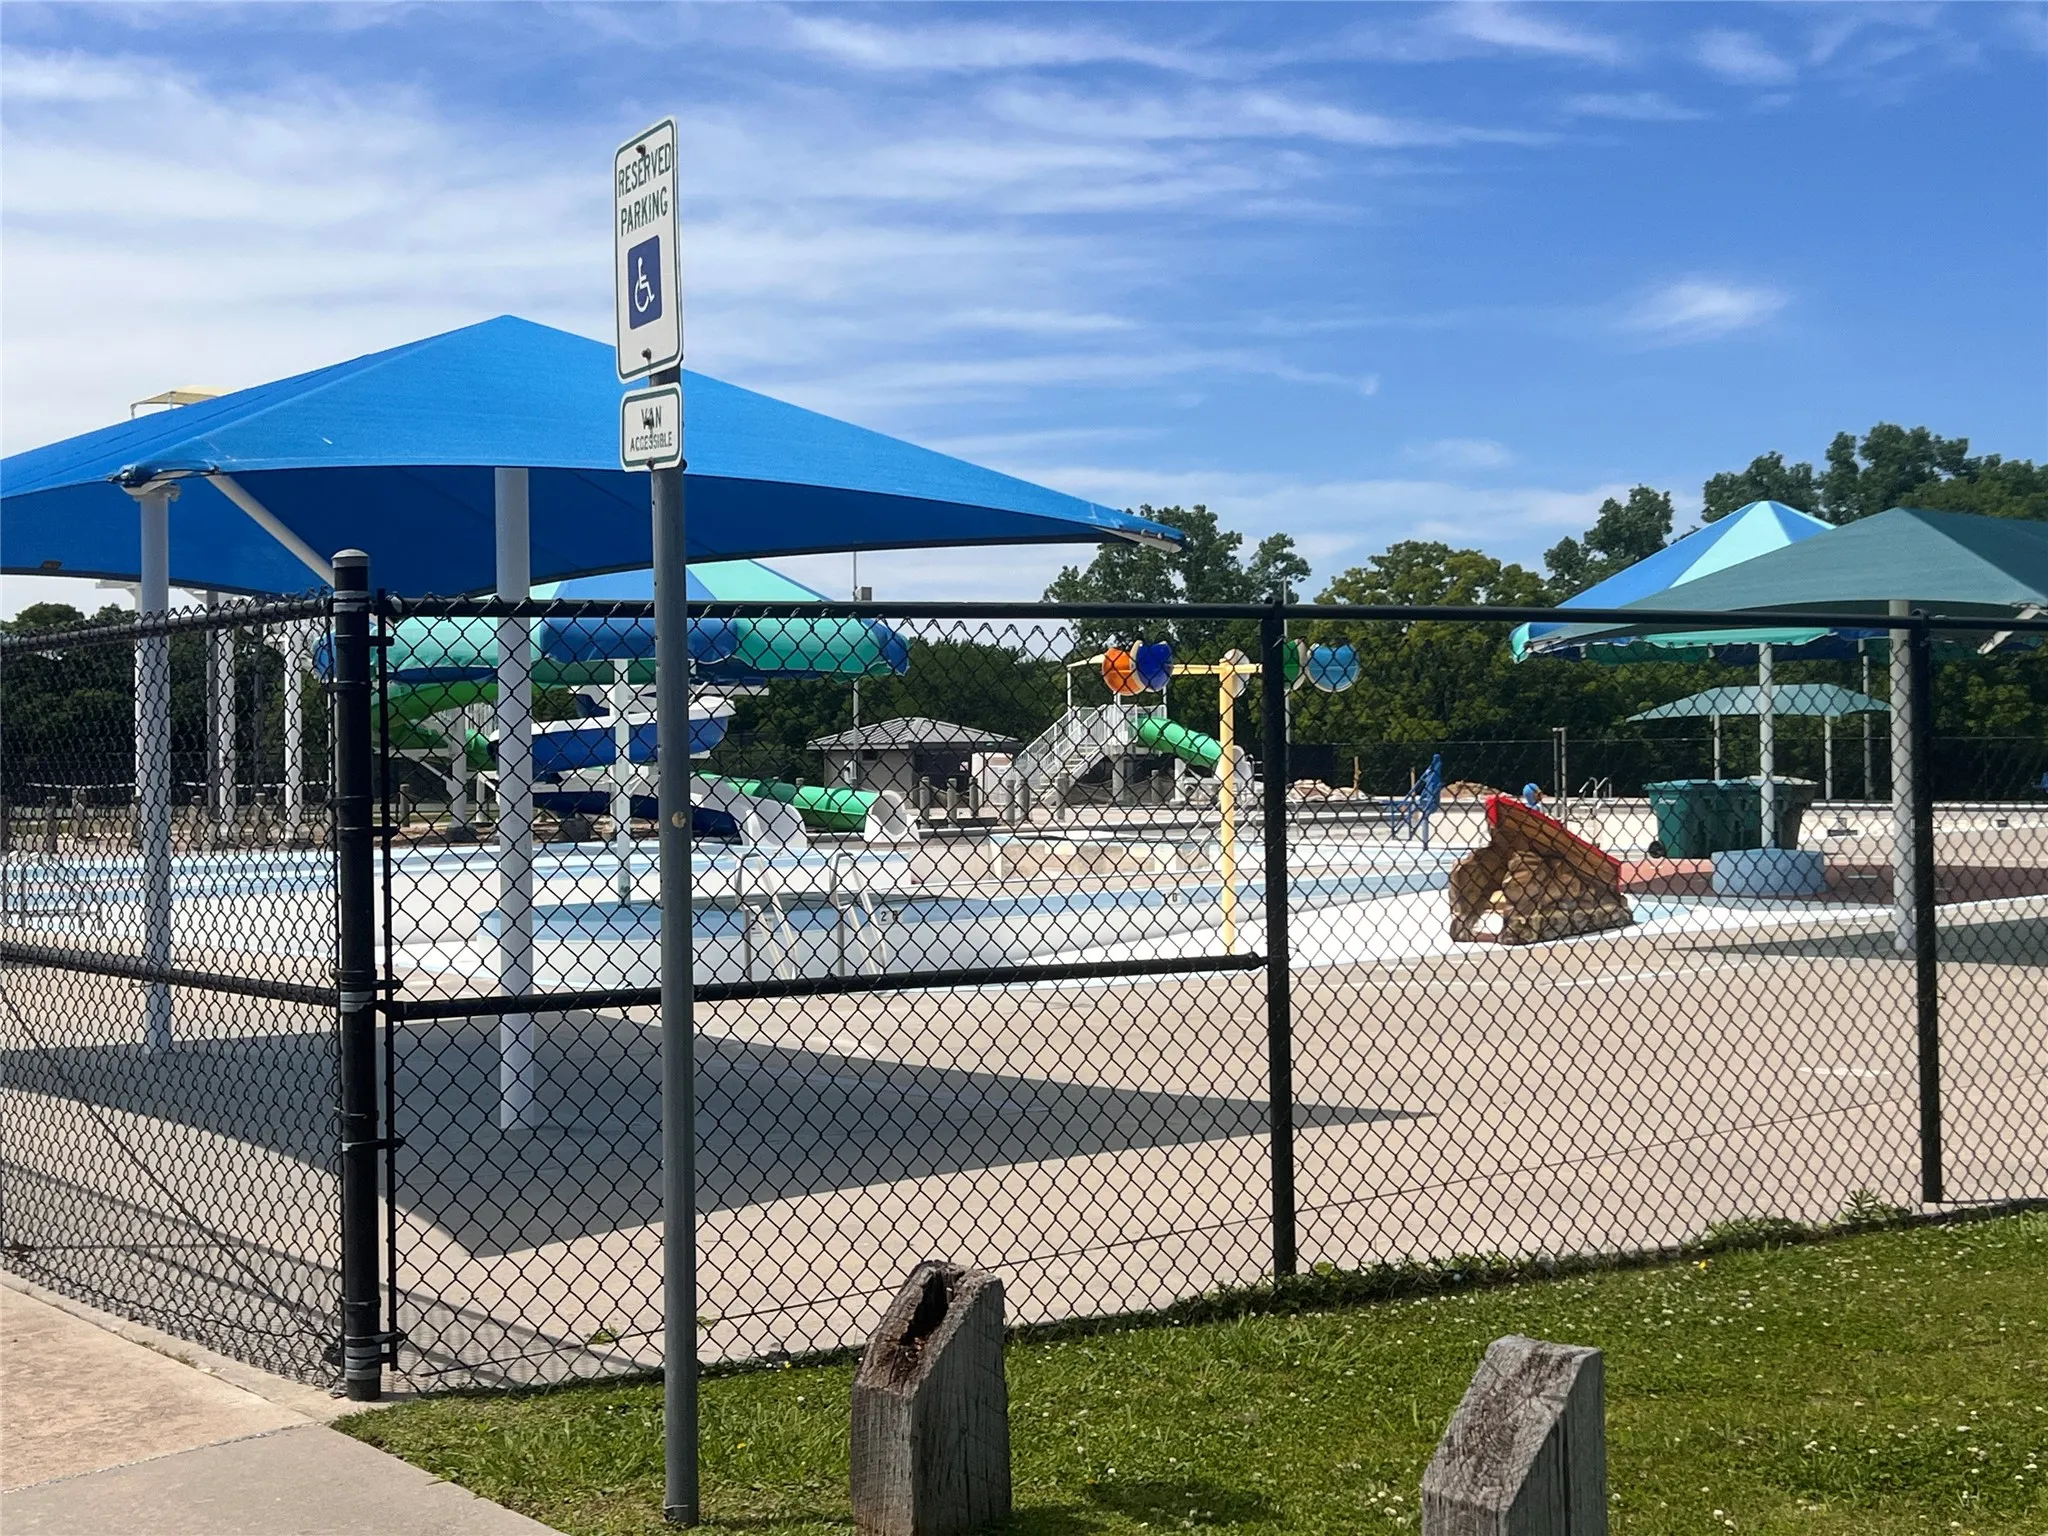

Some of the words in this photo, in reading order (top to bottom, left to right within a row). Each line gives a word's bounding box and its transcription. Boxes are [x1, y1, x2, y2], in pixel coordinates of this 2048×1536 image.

[618, 142, 671, 198] RESERVED
[620, 186, 668, 237] PARKING
[641, 405, 662, 430] VAN
[630, 431, 673, 452] ACCESSIBLE
